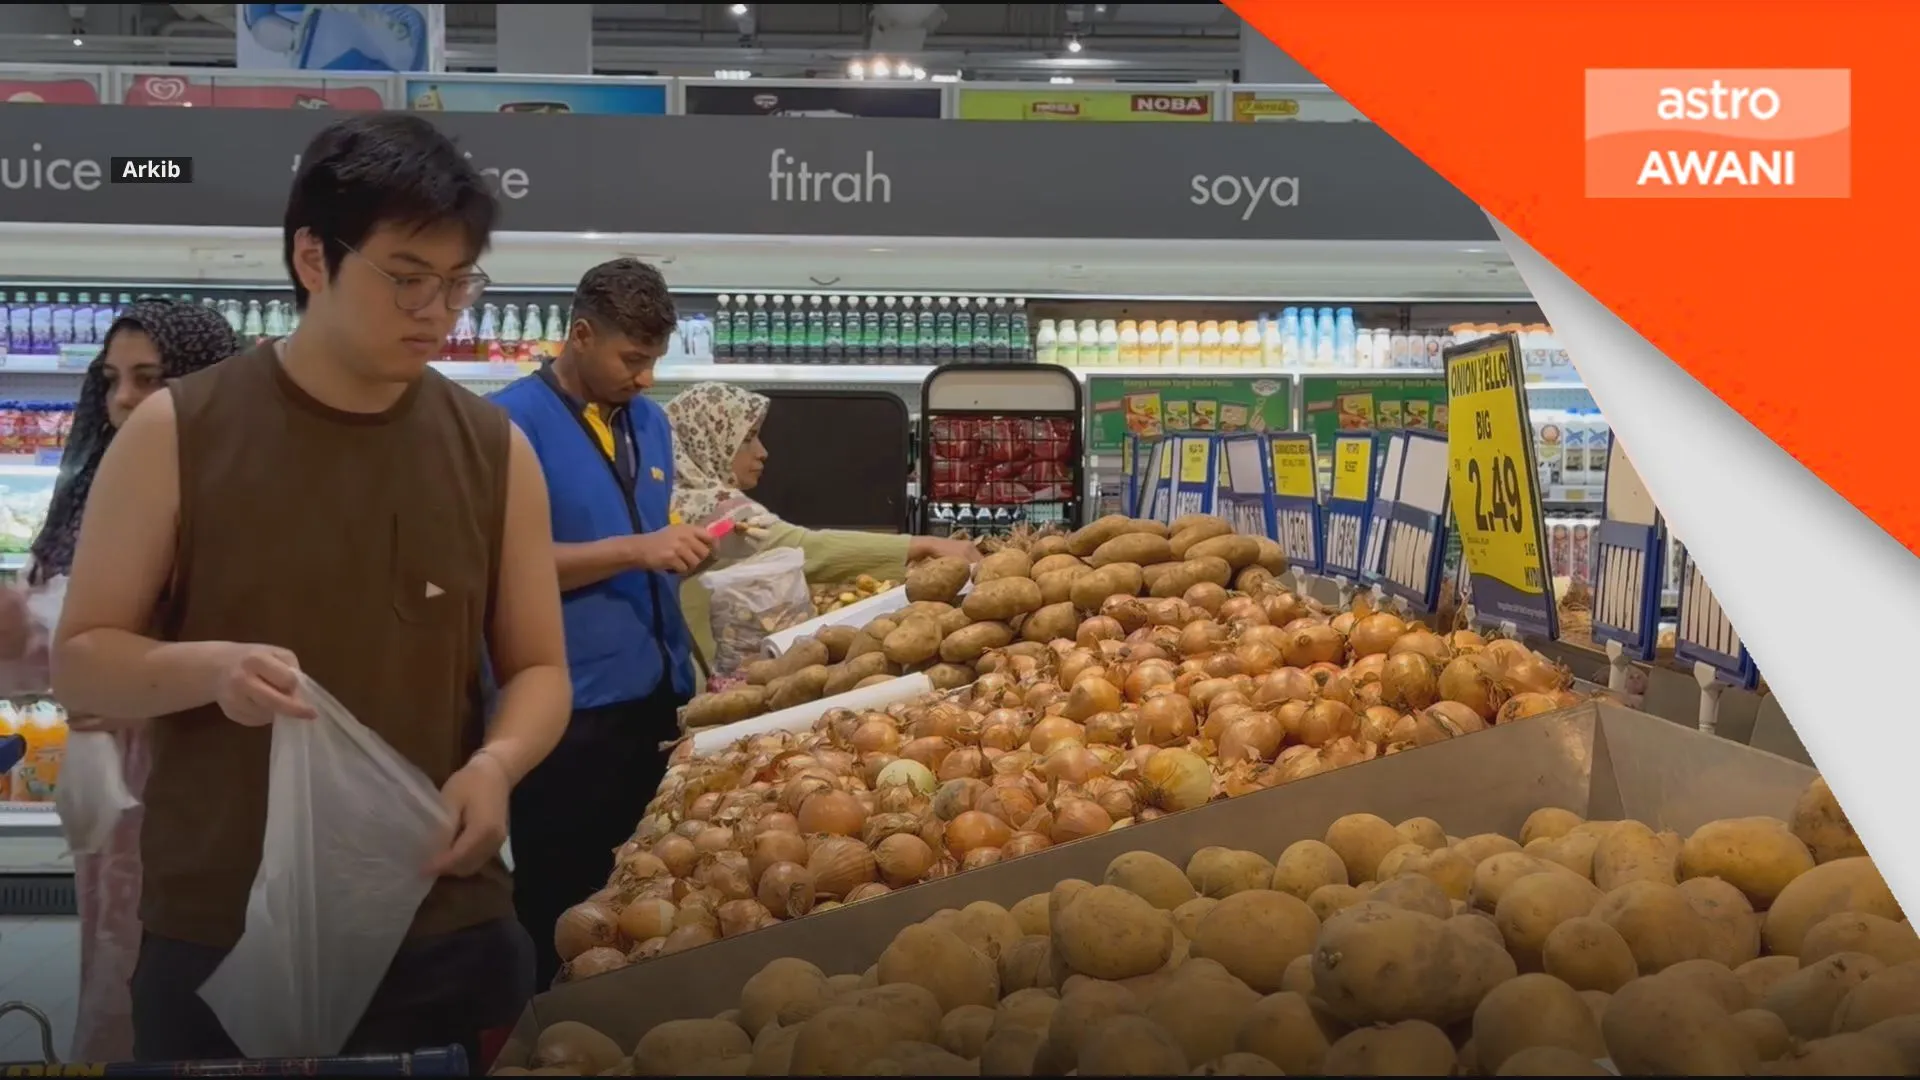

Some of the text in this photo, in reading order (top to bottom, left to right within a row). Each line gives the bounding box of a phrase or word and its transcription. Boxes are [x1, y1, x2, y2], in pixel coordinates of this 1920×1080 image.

[1137, 97, 1201, 112] NOBA
[769, 148, 892, 203] fitrah
[1190, 174, 1300, 220] soya
[1451, 359, 1478, 397] ONION
[1476, 410, 1492, 440] BIG
[1469, 455, 1523, 533] 2.49
